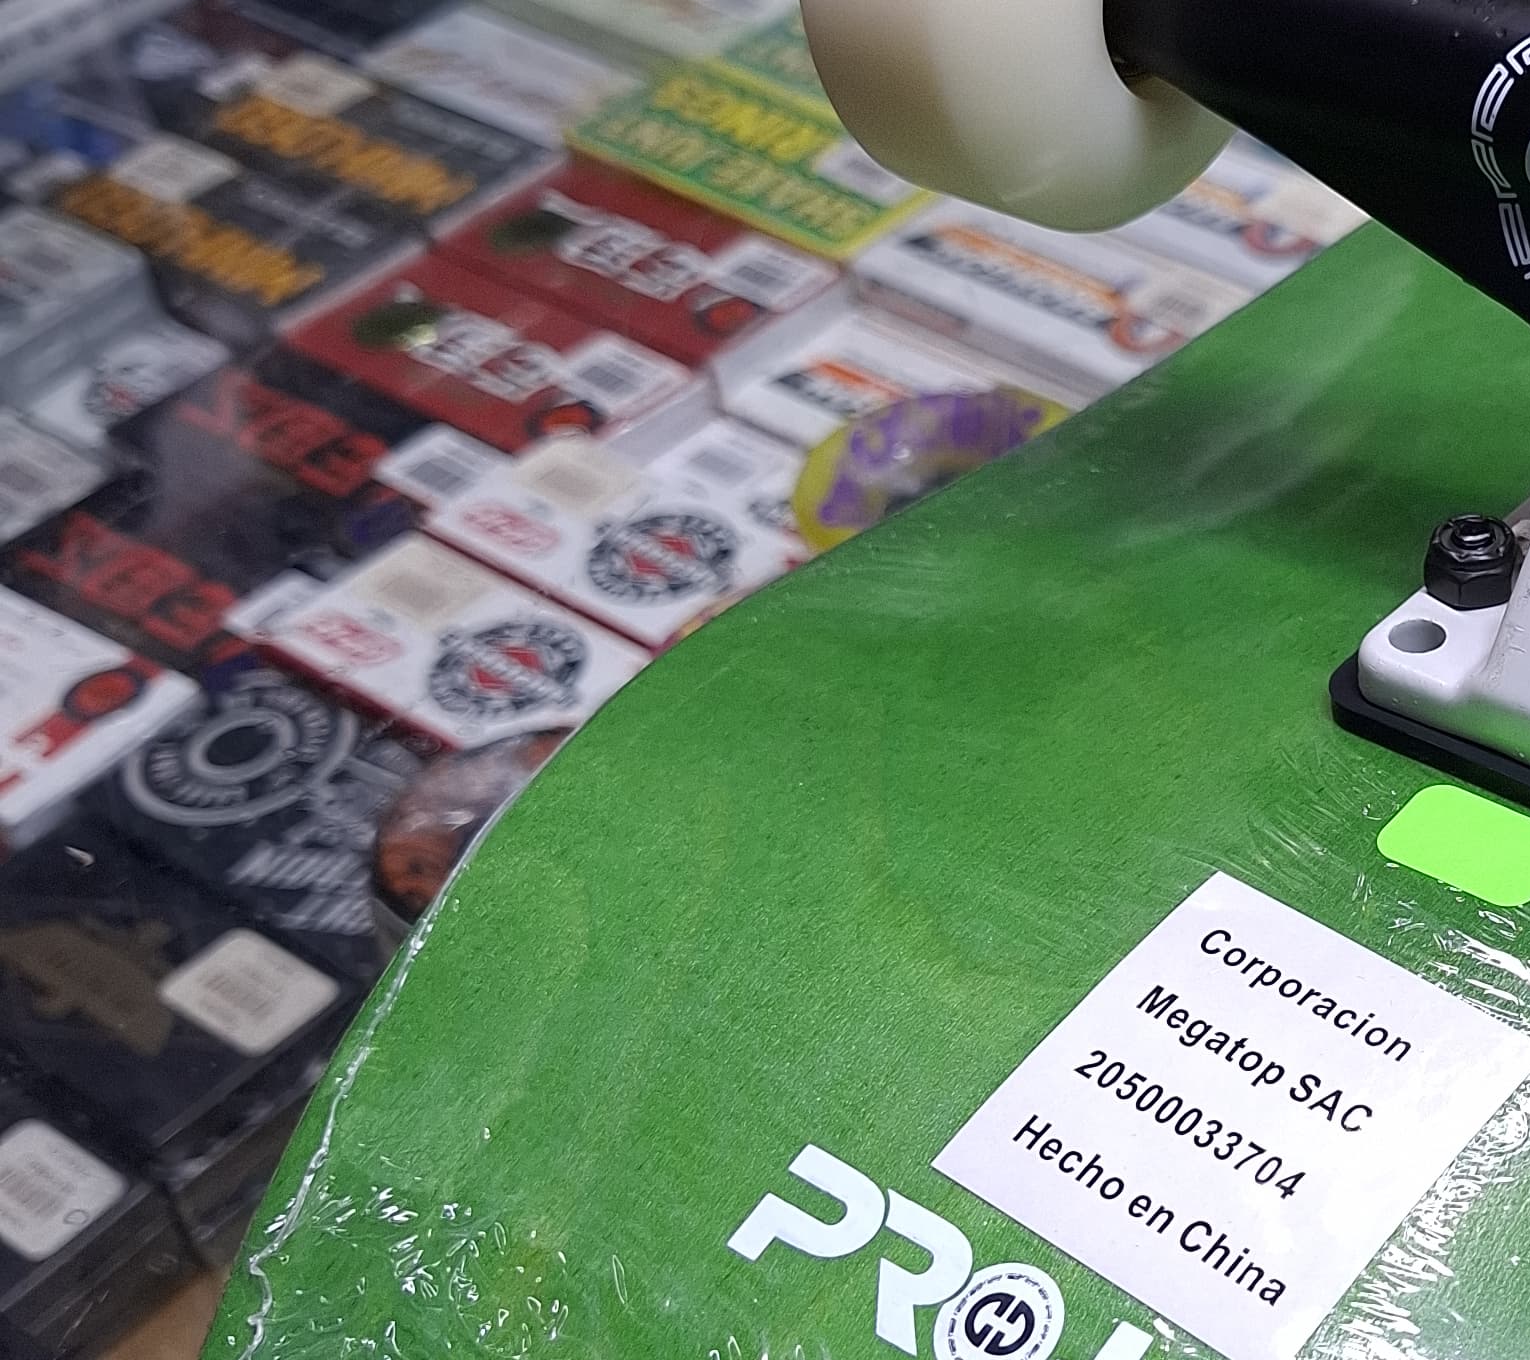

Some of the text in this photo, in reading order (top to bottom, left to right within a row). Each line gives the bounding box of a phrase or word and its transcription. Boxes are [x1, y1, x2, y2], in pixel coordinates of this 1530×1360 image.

[1137, 984, 1375, 1134] Megatop SAC
[1200, 928, 1412, 1062] Corporacion
[1074, 1049, 1306, 1200] 20500033704
[1012, 1114, 1287, 1308] Hecho en China
